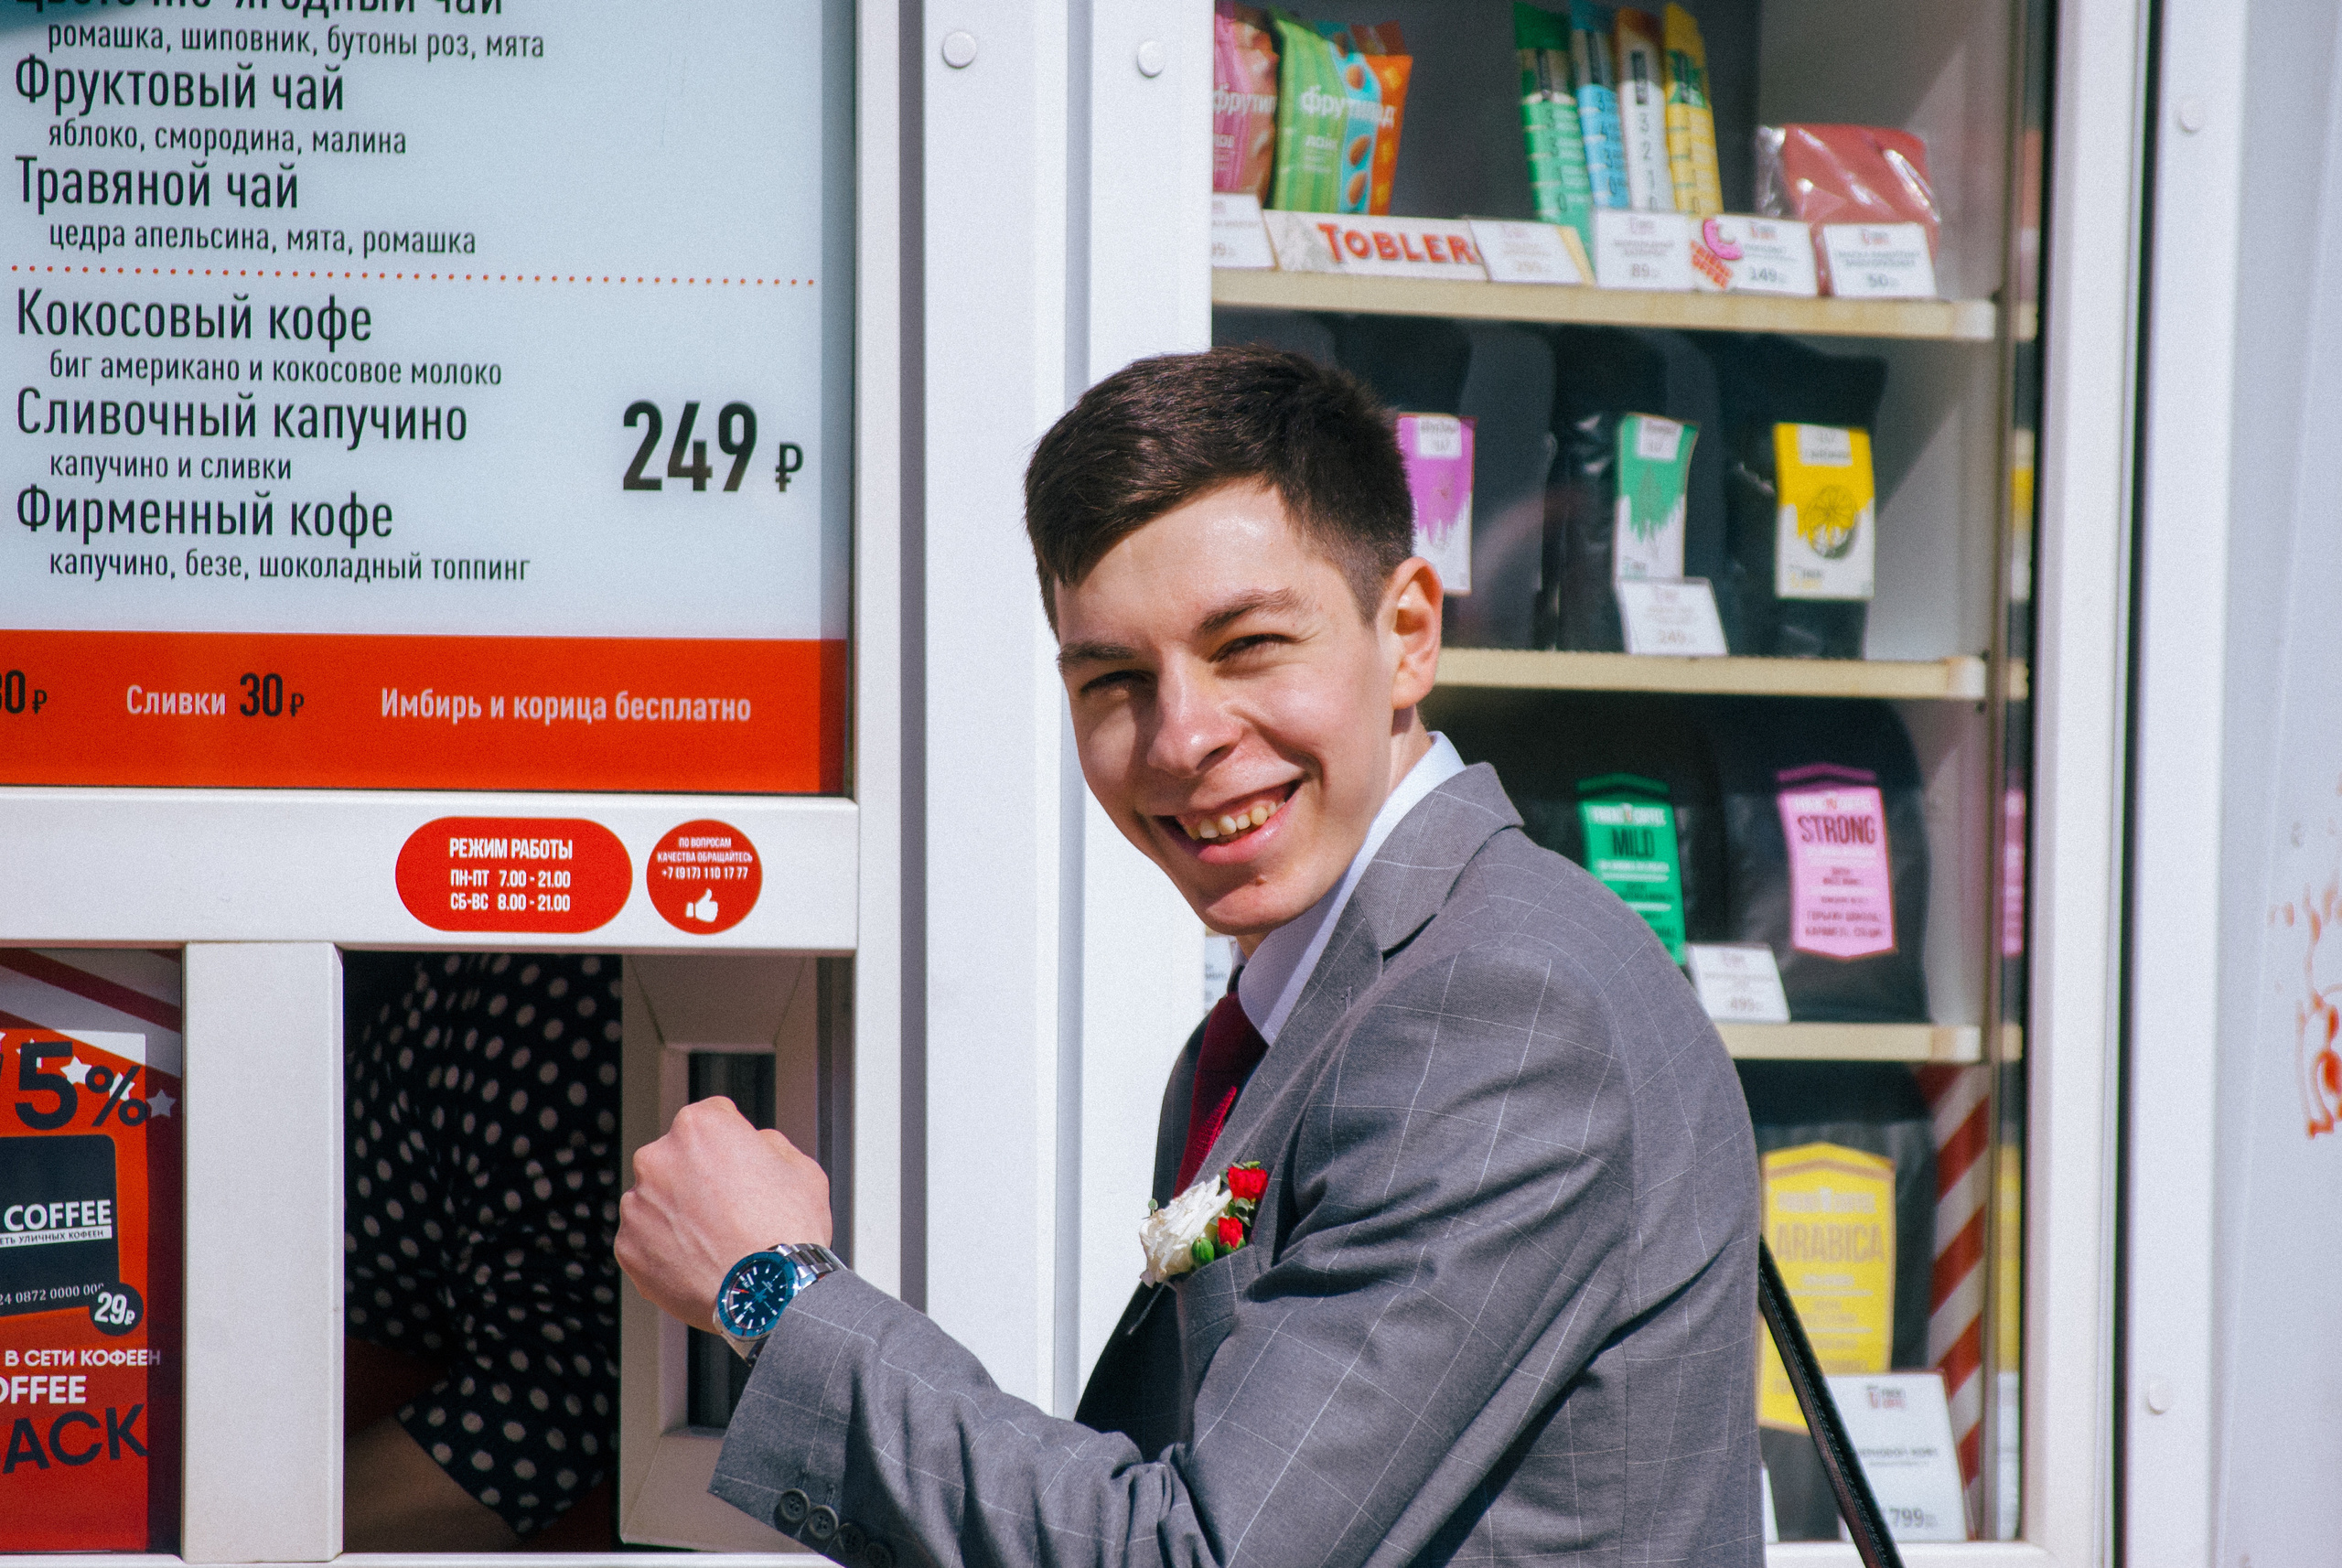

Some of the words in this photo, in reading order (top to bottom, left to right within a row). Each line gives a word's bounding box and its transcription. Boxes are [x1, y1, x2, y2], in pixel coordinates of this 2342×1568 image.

[45, 21, 170, 53] ромашка,
[182, 28, 317, 57] шиповник,
[328, 25, 416, 60] бутоны
[427, 34, 476, 62] роз,
[487, 36, 543, 58] мята
[16, 54, 255, 116] Фруктовый
[273, 65, 342, 110] чай
[49, 118, 145, 152] яблоко,
[155, 127, 301, 157] смородина,
[313, 131, 405, 154] малина
[16, 156, 209, 215] Травяной
[228, 163, 296, 208] чай
[50, 225, 124, 253] цедра
[134, 226, 276, 253] апельсина,
[287, 230, 352, 255] мята,
[363, 231, 475, 259] ромашка
[1317, 221, 1481, 264] TOBLER
[18, 288, 251, 338] Кокосовый
[270, 295, 371, 353] кофе
[50, 349, 91, 378] биг
[101, 358, 240, 386] американо
[250, 360, 262, 381] и
[274, 360, 401, 383] кокосовое
[412, 363, 501, 385] молоко
[17, 387, 255, 437] Сливочный
[274, 404, 466, 451] капучино
[623, 401, 757, 491] 249
[775, 443, 803, 492] ₽
[51, 456, 168, 484] капучино
[178, 457, 191, 478] и
[201, 457, 291, 479] сливки
[17, 484, 273, 545] Фирменный
[292, 491, 392, 549] кофе
[50, 553, 175, 582] капучино,
[186, 548, 249, 580] безе,
[260, 553, 421, 583] шоколадный
[432, 559, 529, 580] топпинг
[0, 669, 27, 717] 0
[127, 685, 225, 714] Сливки
[238, 671, 284, 717] 30
[288, 691, 306, 717] ₽
[382, 688, 482, 725] Имбирь
[491, 696, 504, 718] и
[514, 697, 607, 725] корица
[616, 691, 751, 721] бесплатно
[679, 837, 693, 848] ПО
[688, 837, 731, 848] ВОПРОСАМ
[1611, 828, 1656, 858] MILD
[1797, 814, 1876, 845] STRONG
[450, 838, 508, 858] РЕЖИМ
[511, 839, 573, 859] РАБОТЫ
[657, 852, 699, 862] КАЧЕСТВА
[694, 851, 753, 863] ОБРАЩАЙТЕСЬ
[451, 869, 489, 886] ПН-ПТ
[500, 870, 526, 887] 7.00
[538, 870, 571, 887] 21.00
[661, 866, 674, 879] +7
[675, 866, 701, 879] (917)
[704, 866, 721, 879] 110
[724, 866, 735, 879] 17
[736, 866, 748, 879] 77
[451, 893, 489, 910] СБ-ВС
[498, 894, 526, 910] 8.00
[538, 894, 570, 911] 21.00
[0, 1041, 148, 1131] 5%
[4, 1198, 113, 1232] COFFEE
[18, 1231, 67, 1245] УЛИЧНЫХ
[69, 1228, 104, 1240] КОФЕЕН
[1776, 1221, 1886, 1262] ARABICA
[16, 1289, 47, 1304] 0872
[49, 1284, 81, 1300] 0000
[5, 1350, 20, 1367] В
[24, 1349, 76, 1367] СЕТИ
[81, 1349, 161, 1367] КОФЕЕН
[2, 1403, 149, 1475] ACK
